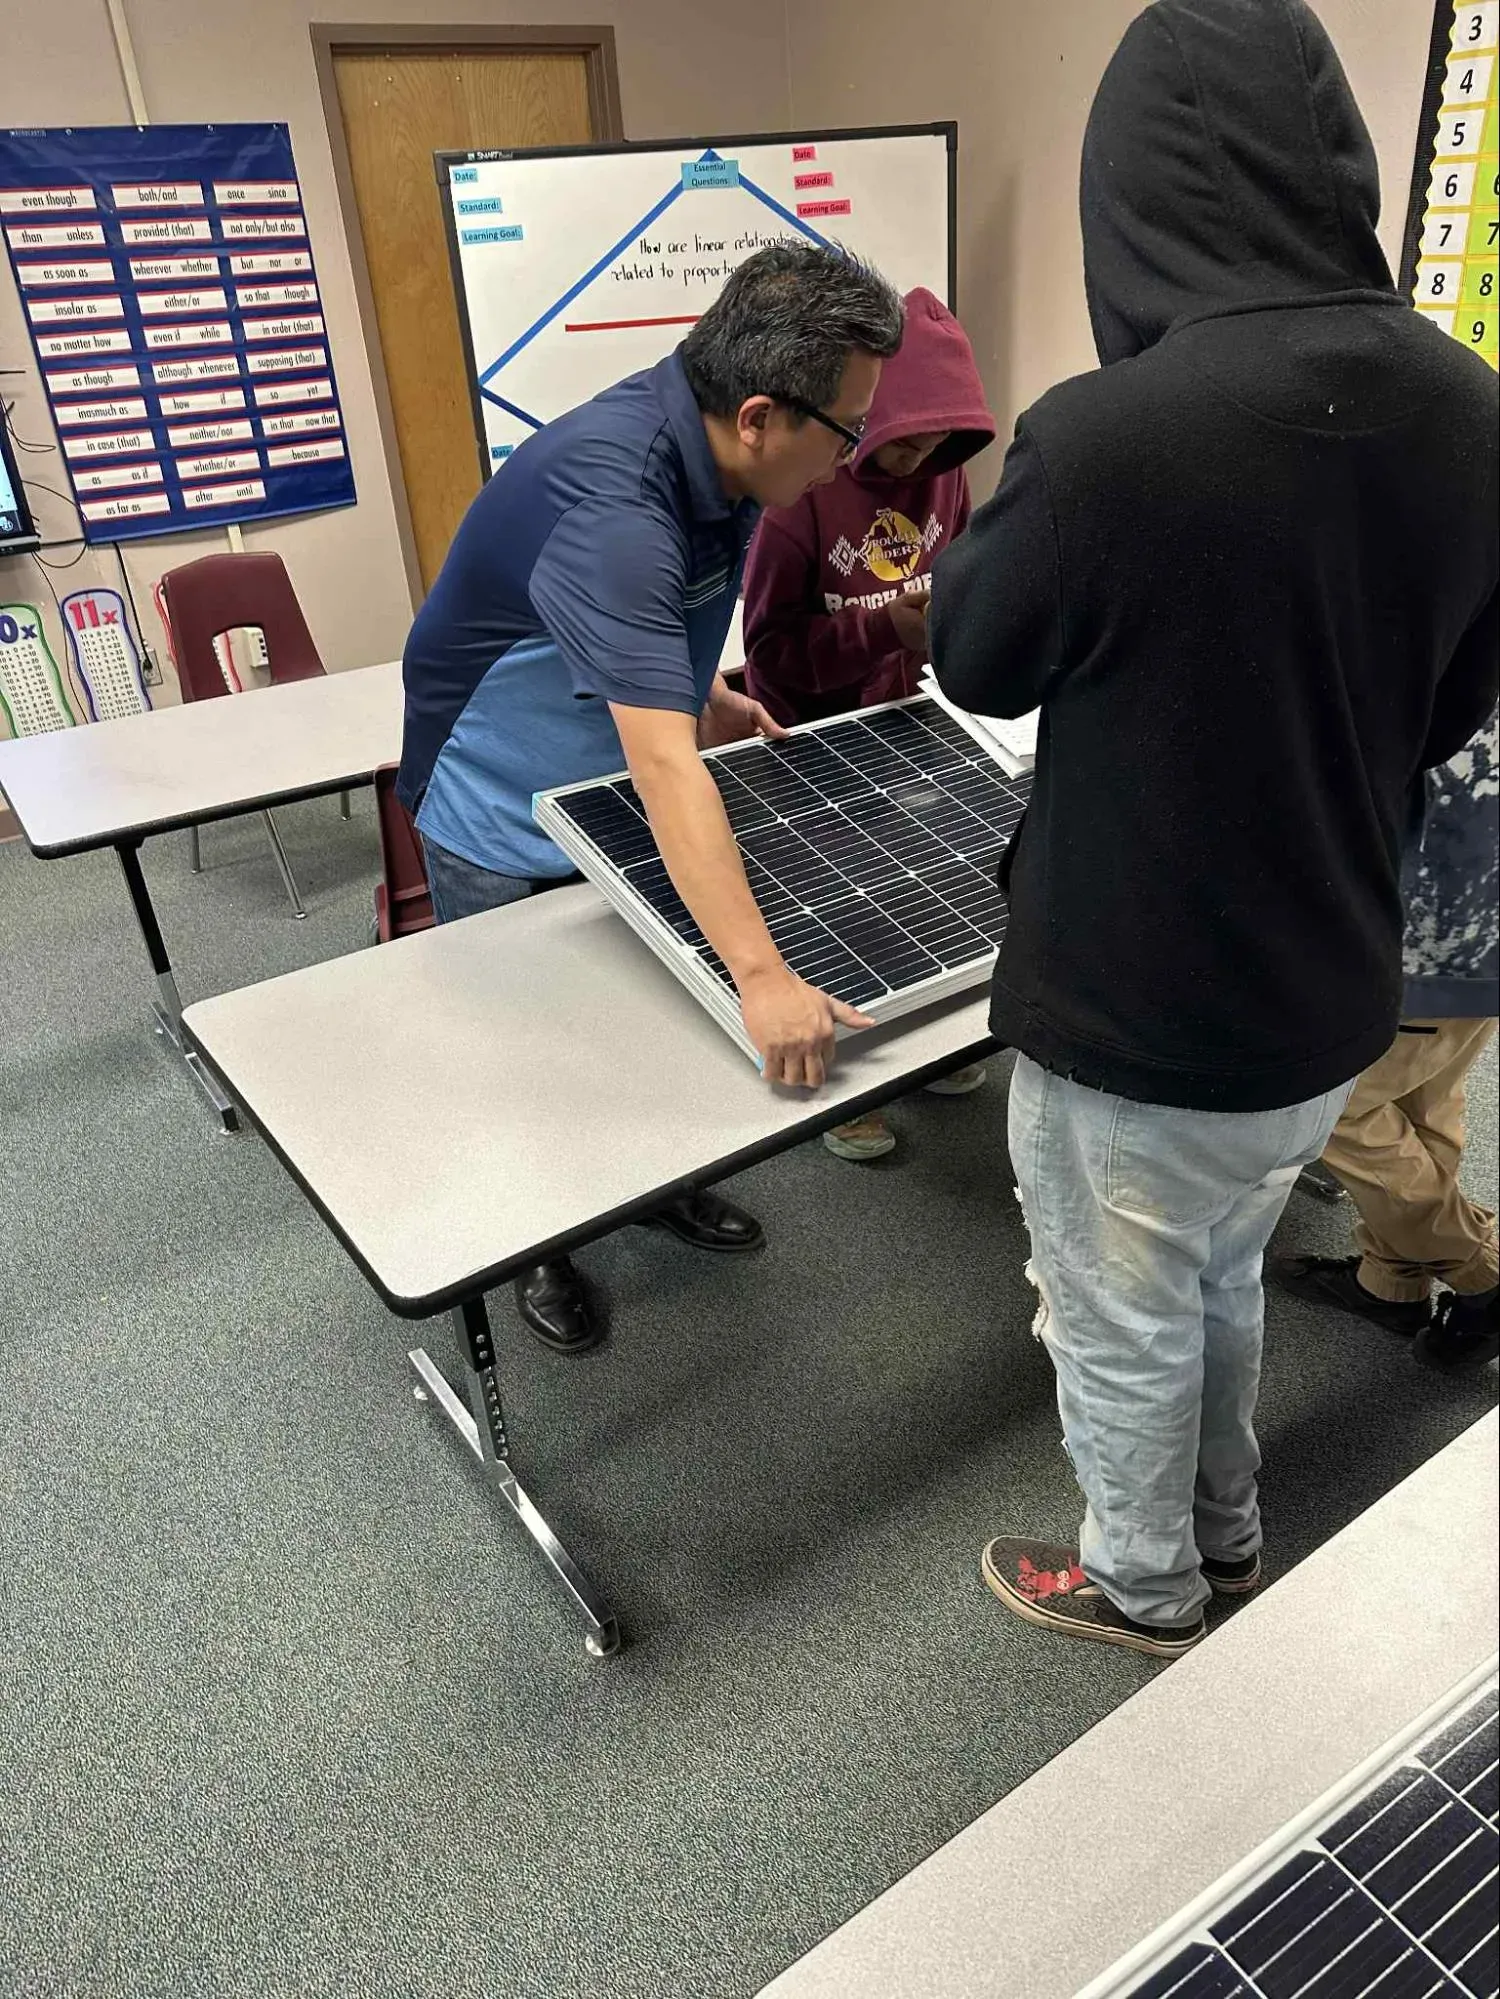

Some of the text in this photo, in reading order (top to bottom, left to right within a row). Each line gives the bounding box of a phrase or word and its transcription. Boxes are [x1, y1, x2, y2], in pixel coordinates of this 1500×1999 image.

[1468, 15, 1482, 41] 3
[1460, 69, 1474, 95] 4
[1452, 122, 1466, 147] 5
[694, 164, 726, 172] Essential
[692, 178, 728, 187] Questions
[1445, 174, 1458, 198] 6
[22, 190, 77, 207] even though
[138, 187, 178, 202] both/and
[228, 190, 246, 200] once
[268, 187, 287, 198] since
[460, 200, 500, 212] Standard:
[800, 205, 829, 214] Learning
[67, 228, 94, 241] unless
[134, 222, 195, 239] provided (that)
[231, 221, 295, 235] not only/but also
[1439, 222, 1500, 247] 7 7
[22, 231, 43, 243] than
[464, 228, 521, 242] Learning Goal:
[640, 238, 661, 254] How
[668, 242, 687, 253] are
[695, 234, 726, 253] linear
[181, 261, 213, 273] whether
[241, 257, 254, 270] but
[270, 258, 282, 268] nor
[295, 257, 303, 266] or
[44, 268, 88, 280] as soon as
[134, 263, 172, 276] wherever
[611, 263, 654, 281] related
[661, 262, 674, 278] to
[1431, 273, 1493, 296] 8 8
[245, 290, 271, 303] so that
[285, 287, 310, 300] though
[165, 295, 201, 309] either/or
[55, 302, 97, 316] insofar as
[263, 317, 314, 335] in order (that)
[1471, 320, 1485, 344] 9
[154, 330, 181, 344] even if
[200, 327, 221, 340] while
[51, 335, 112, 352] no matter how
[258, 353, 316, 369] supposing (that)
[157, 364, 194, 380] although
[199, 362, 235, 375] whenever
[73, 373, 113, 386] as though
[271, 391, 279, 400] so
[307, 385, 318, 398] yet
[173, 396, 190, 410] how
[221, 394, 226, 406] if
[79, 404, 128, 420] inasmuch as
[271, 418, 294, 431] in that
[306, 415, 336, 426] now that
[190, 426, 233, 440] neither/nor
[87, 436, 141, 452] in case (that)
[292, 449, 320, 461] because
[193, 458, 236, 474] whether/or
[132, 467, 150, 480] as if
[92, 476, 102, 485] as
[196, 490, 215, 503] after
[237, 486, 253, 498] until
[106, 501, 141, 515] as far as
